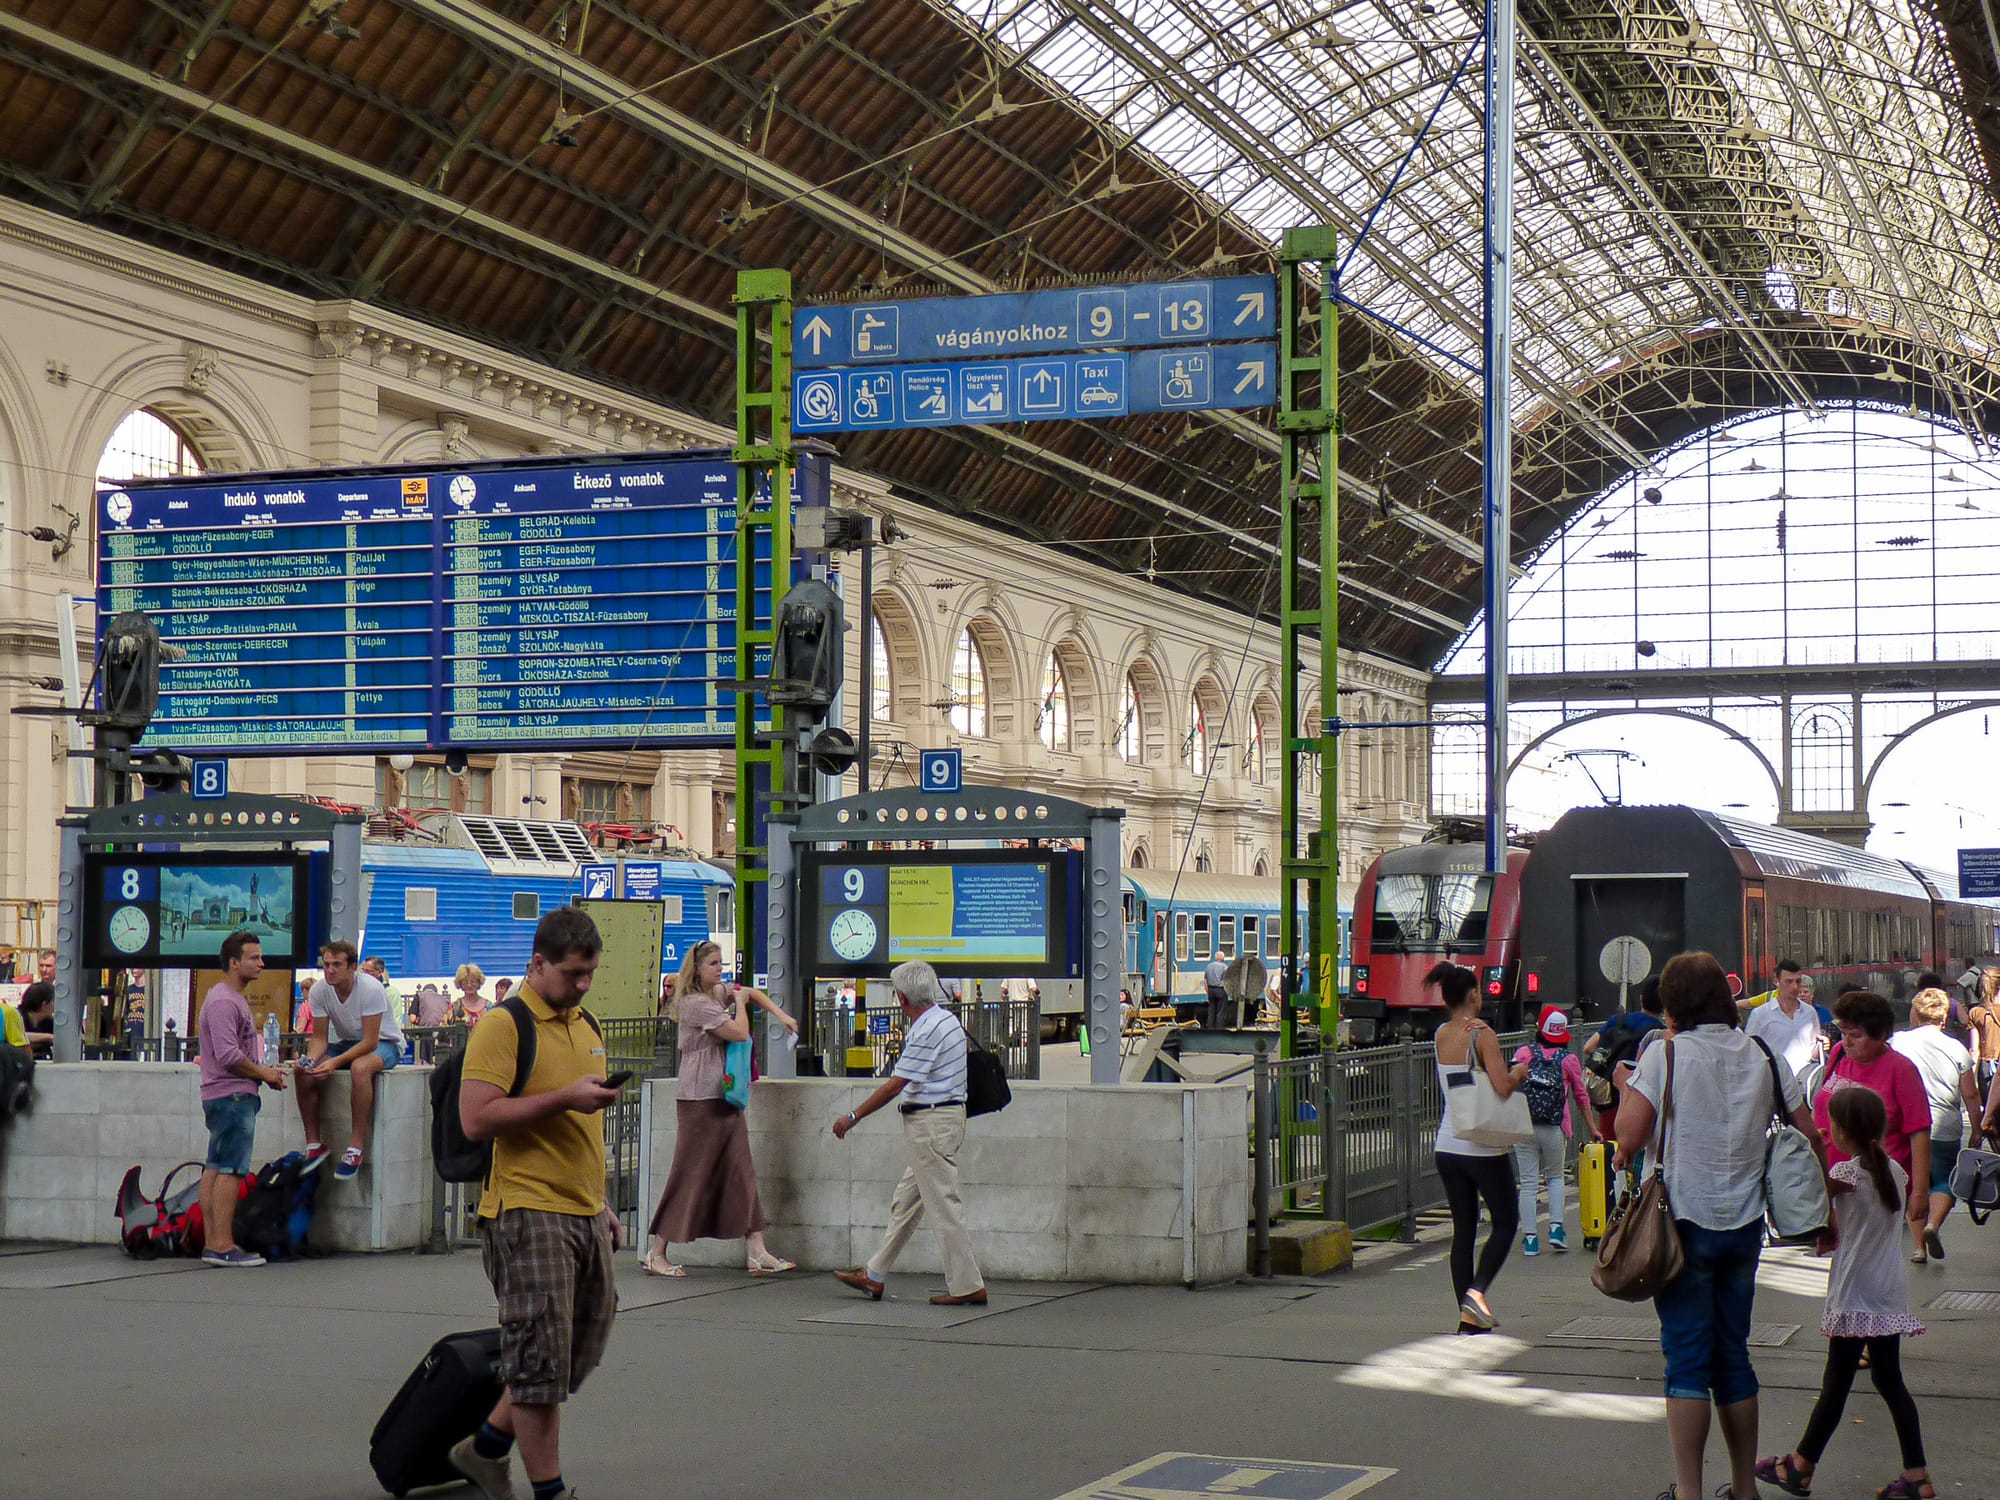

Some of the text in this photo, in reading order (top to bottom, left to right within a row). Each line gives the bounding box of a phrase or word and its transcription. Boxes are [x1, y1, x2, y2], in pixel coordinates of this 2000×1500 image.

[936, 324, 1068, 349] vágányokhoz
[1090, 306, 1112, 337] 9
[1164, 299, 1204, 332] 13
[1082, 366, 1108, 379] Taxi
[831, 410, 839, 421] 2
[574, 471, 664, 490] Érkező vonatok
[224, 489, 306, 508] Induló vonatok
[405, 495, 425, 505] MÁV
[479, 520, 490, 529] EC
[519, 556, 597, 568] EGER-Füzesabony
[355, 692, 383, 704] Tettye
[646, 724, 675, 734] ENDRE
[269, 731, 285, 742] ADY
[289, 730, 316, 741] ENDRE
[931, 759, 950, 785] 9
[202, 767, 218, 791] 8
[121, 867, 140, 900] 8
[843, 867, 865, 902] 9
